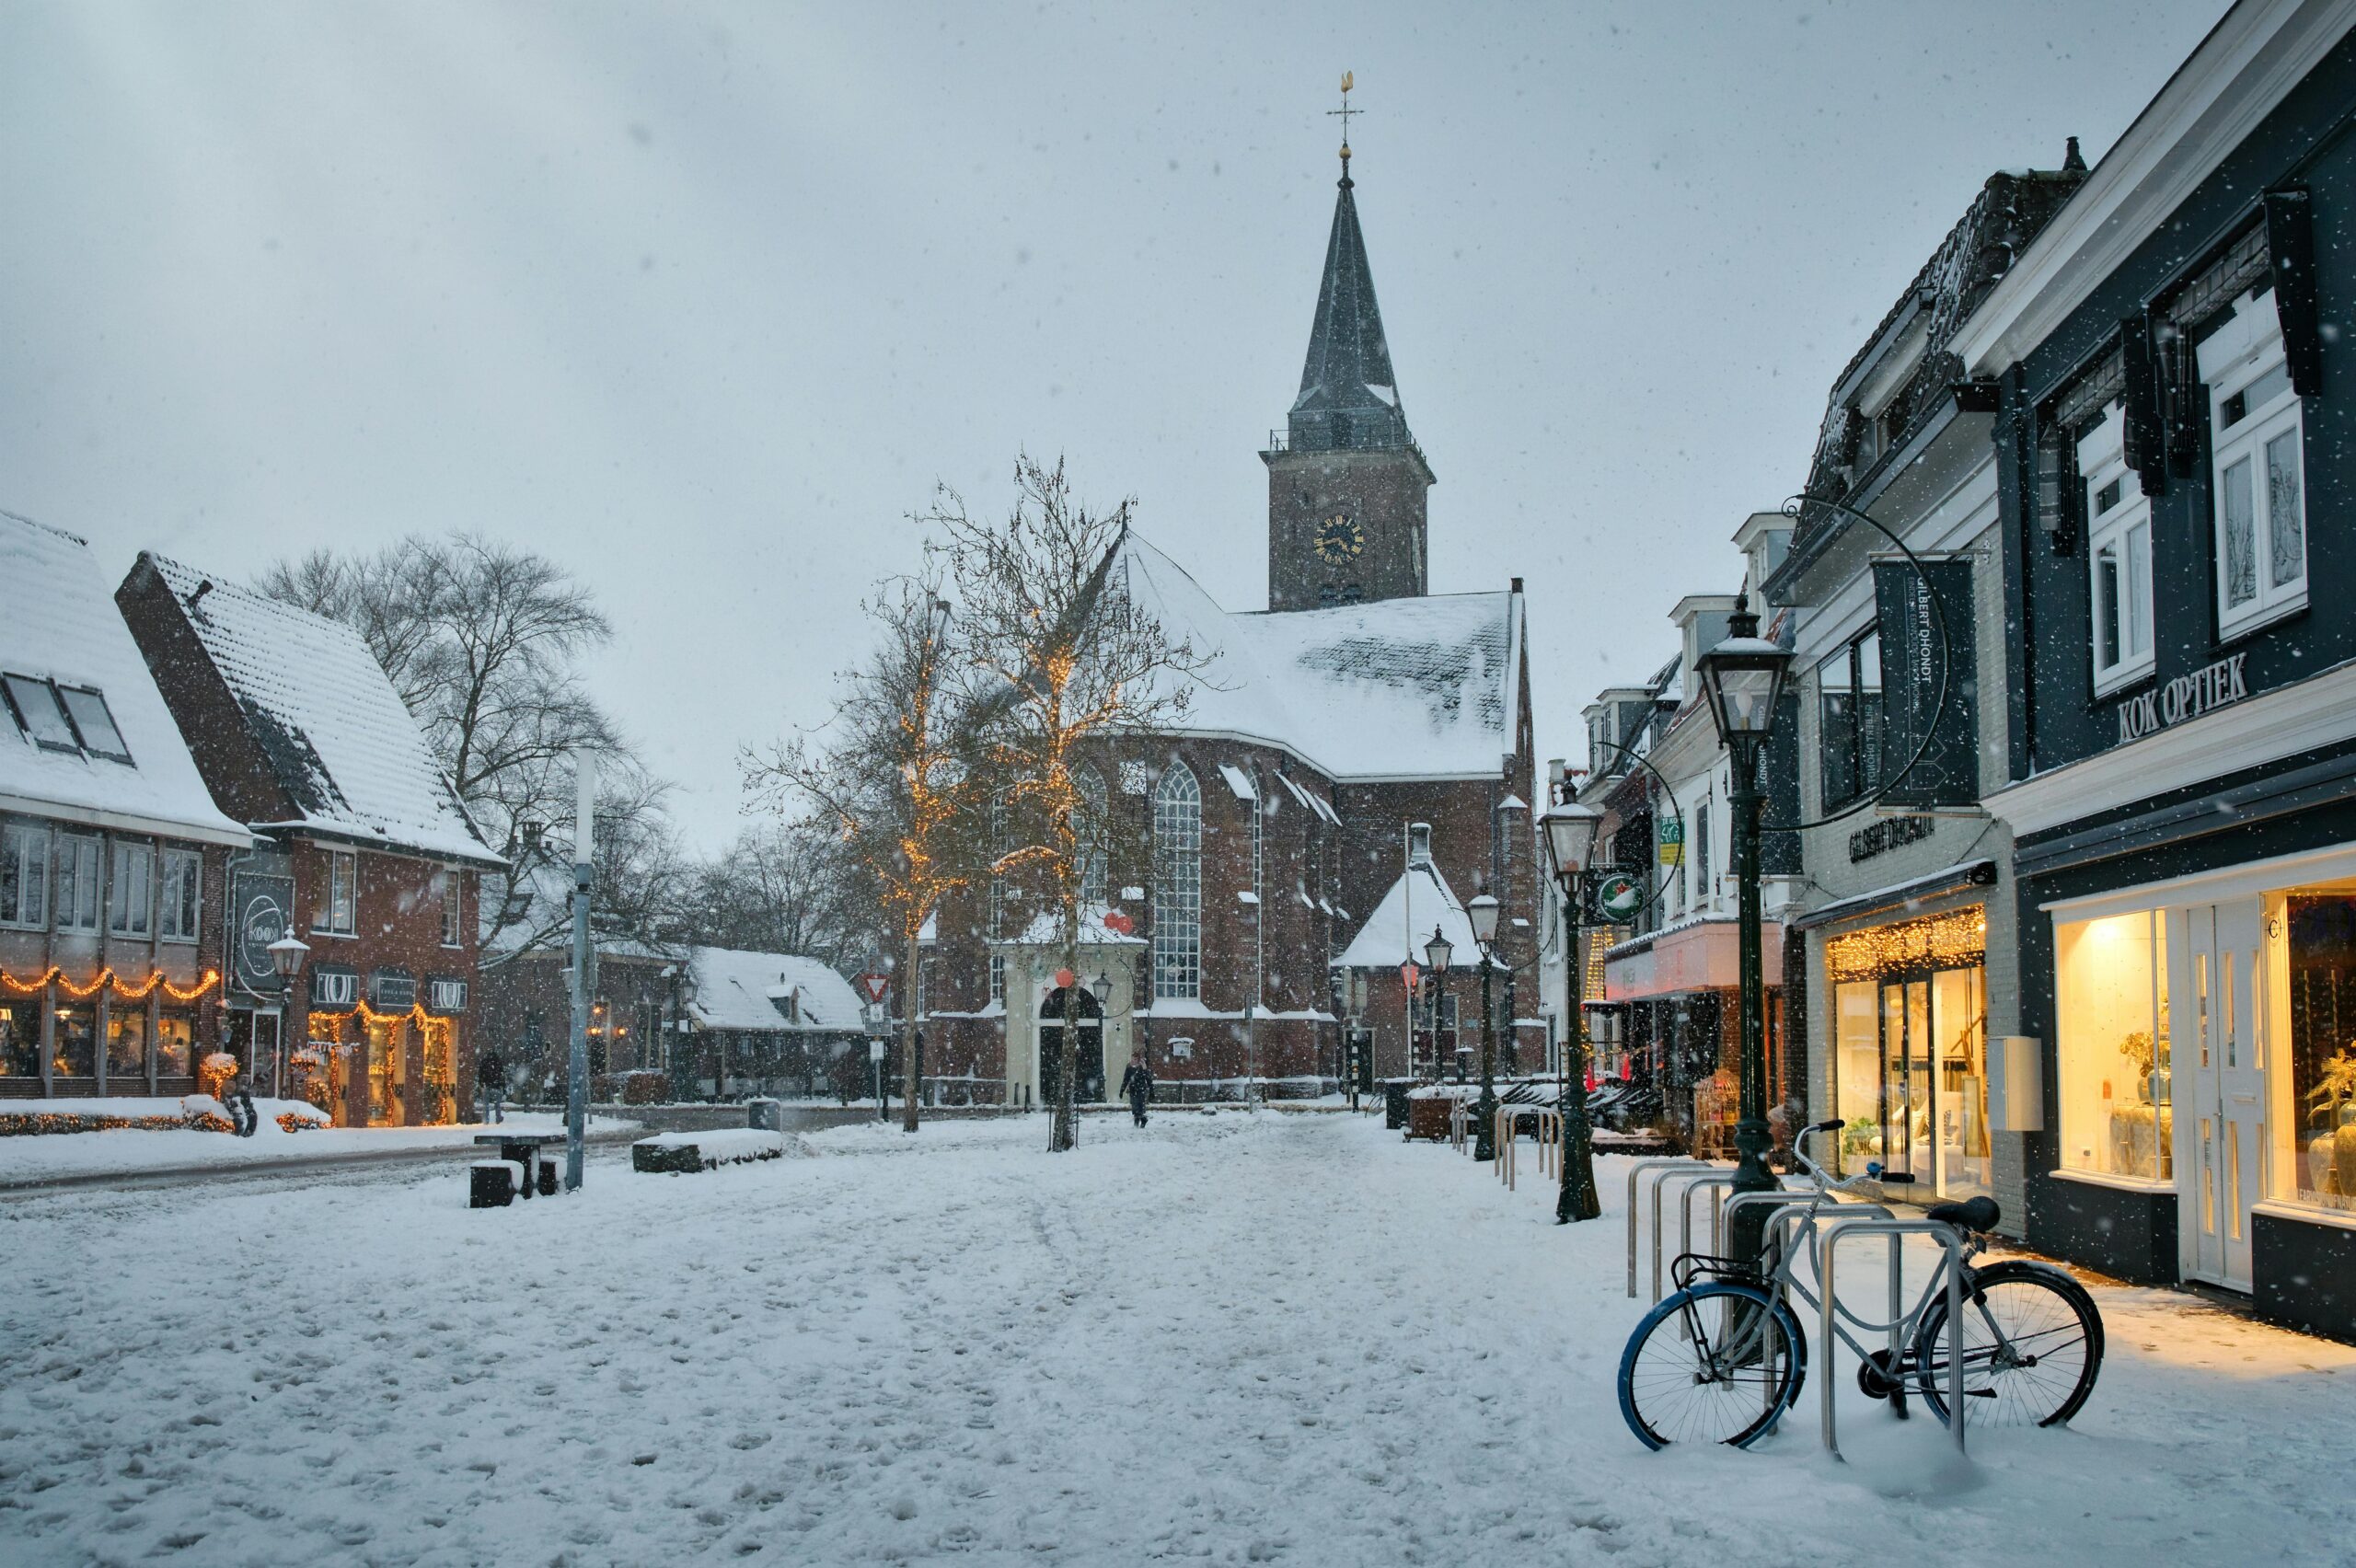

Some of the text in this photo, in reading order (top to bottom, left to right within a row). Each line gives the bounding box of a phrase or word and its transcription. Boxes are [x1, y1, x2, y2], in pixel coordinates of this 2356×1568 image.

[1917, 577, 1932, 683] GILBERT DHONDT
[2118, 651, 2247, 740] KOK OPTIEK
